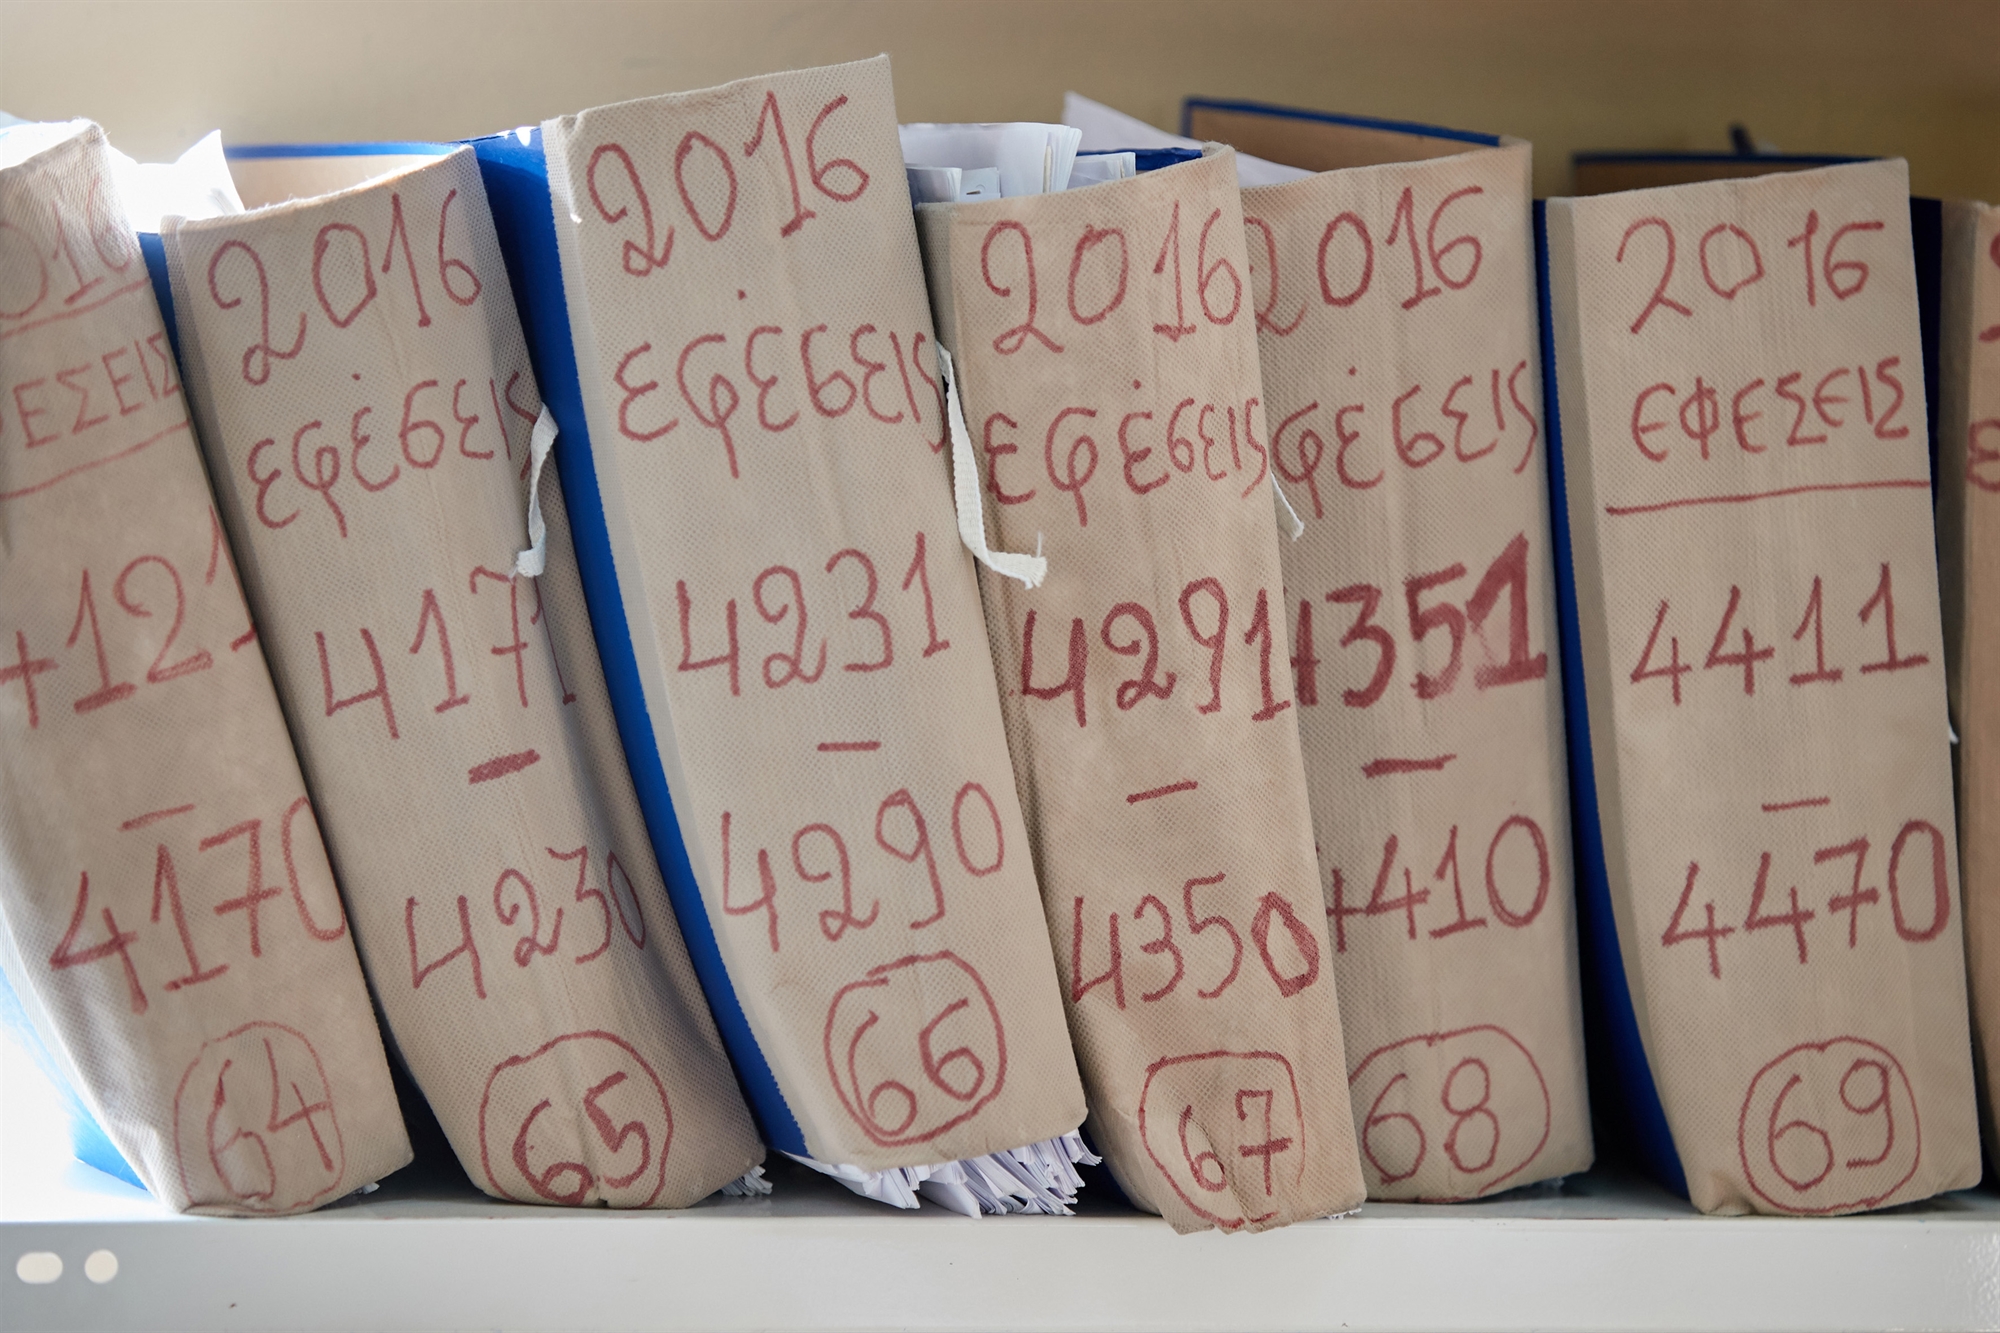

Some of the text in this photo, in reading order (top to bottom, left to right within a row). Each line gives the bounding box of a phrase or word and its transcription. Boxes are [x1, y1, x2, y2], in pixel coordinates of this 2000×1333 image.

[0, 177, 133, 318] 016
[586, 90, 870, 276] 2016
[207, 188, 482, 386] 2016
[980, 200, 1242, 355] 2016
[1244, 187, 1483, 336] 2016
[1616, 209, 1884, 334] 2016
[0, 331, 180, 448] ΕΣΕΙΣ
[1271, 360, 1538, 519] φέσεις
[677, 531, 950, 696] 4231
[1020, 576, 1291, 727] 4291
[1629, 561, 1930, 706] 4411
[49, 796, 346, 1016] 4170
[405, 845, 646, 1000] 4230
[721, 781, 1005, 952] 4290
[1072, 871, 1320, 1009] 4350
[1661, 819, 1950, 980] 4470
[207, 1037, 334, 1200] 64
[512, 1071, 651, 1206] 65
[849, 998, 985, 1137] 66
[1178, 1088, 1294, 1197] 67
[1363, 1056, 1500, 1185] 68
[1768, 1057, 1894, 1191] 69
